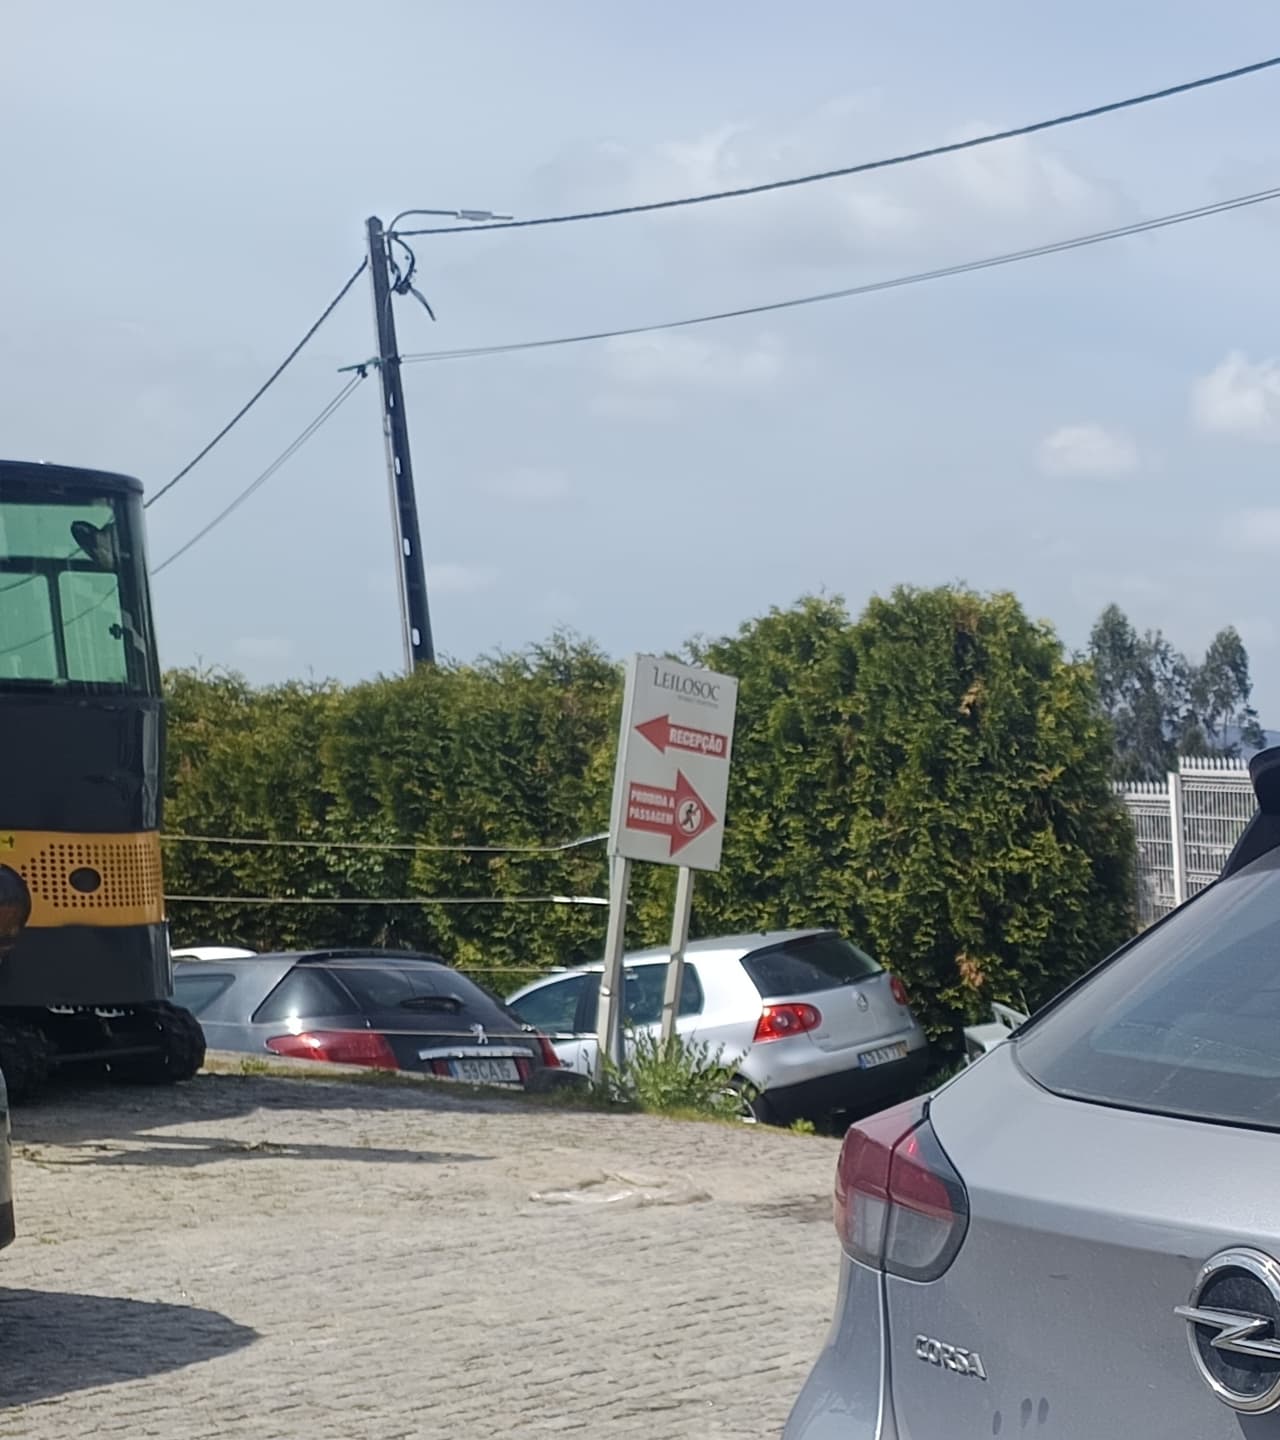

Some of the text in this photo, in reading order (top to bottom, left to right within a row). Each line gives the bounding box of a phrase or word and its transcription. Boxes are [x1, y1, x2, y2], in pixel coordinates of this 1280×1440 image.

[653, 665, 721, 701] LEILOSOC
[669, 727, 723, 754] RECEPÇÃO
[629, 807, 674, 825] PASSAGEM
